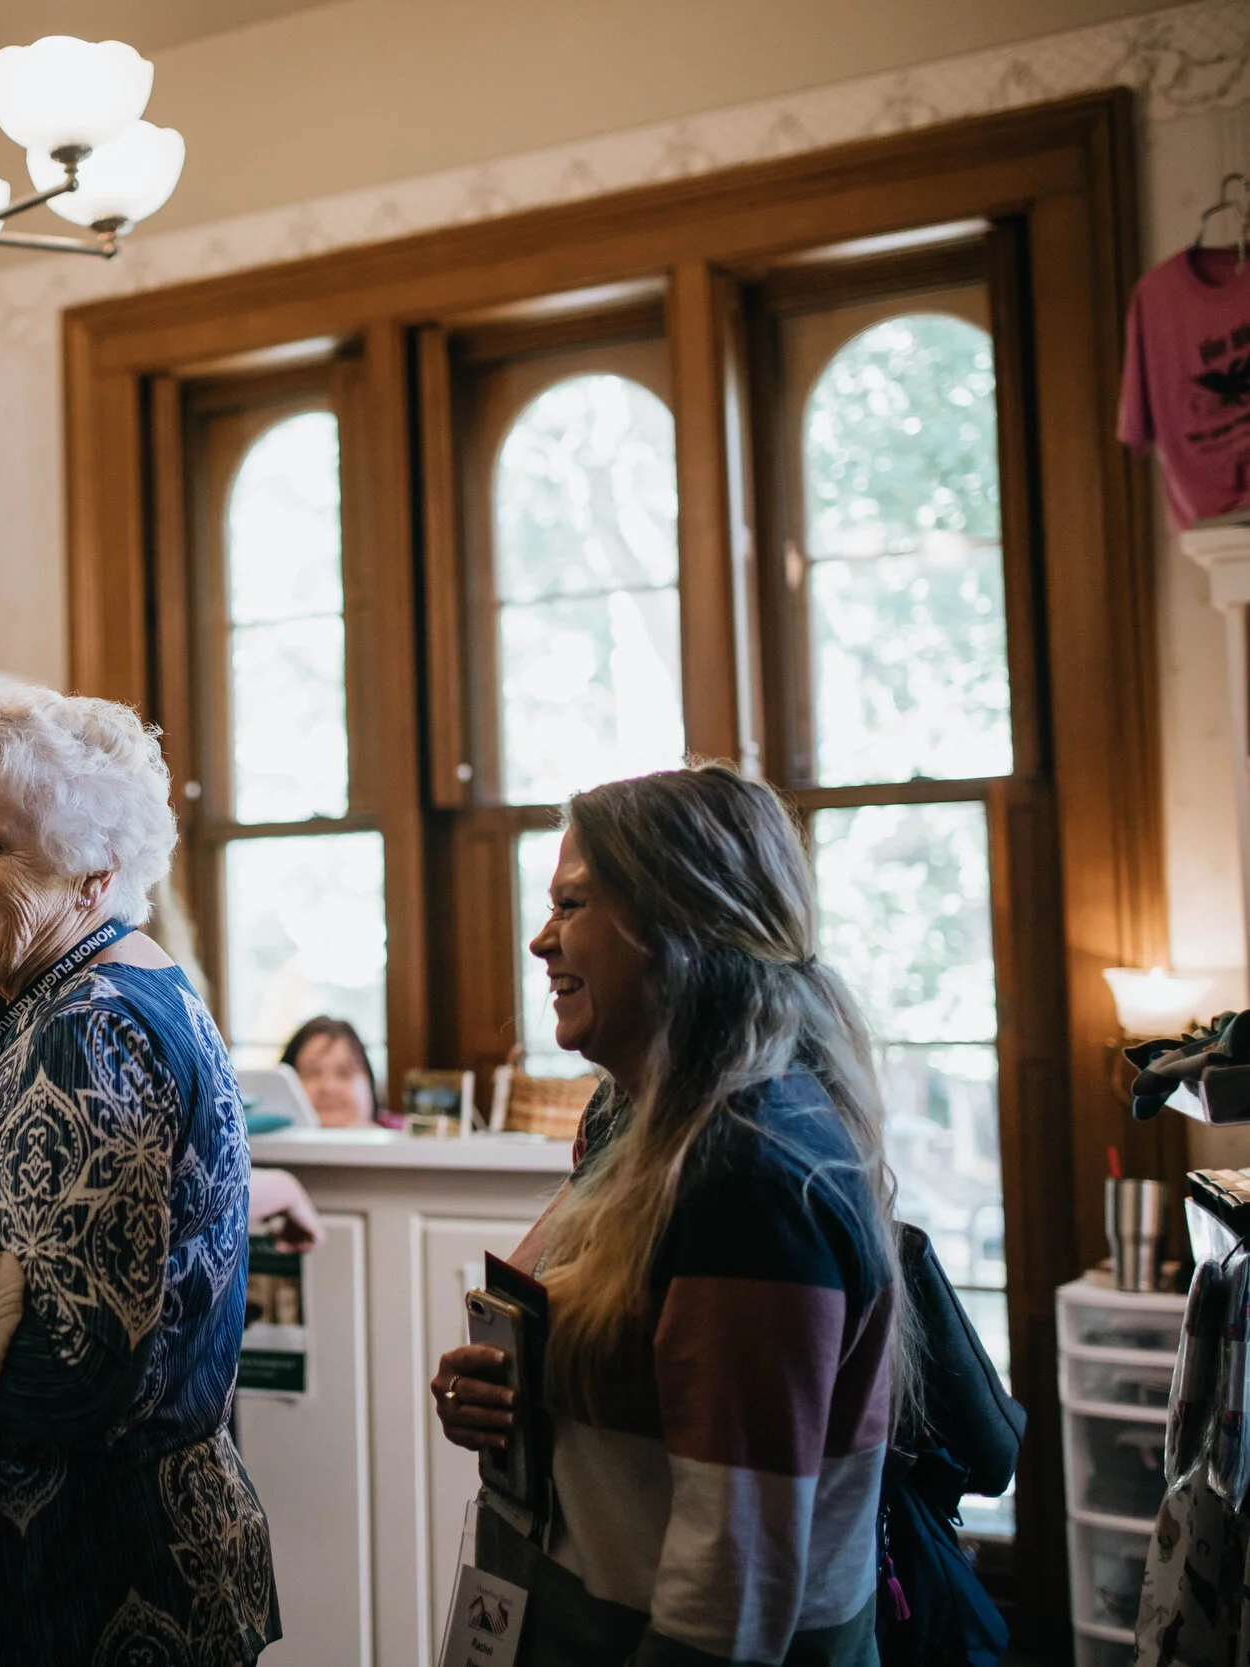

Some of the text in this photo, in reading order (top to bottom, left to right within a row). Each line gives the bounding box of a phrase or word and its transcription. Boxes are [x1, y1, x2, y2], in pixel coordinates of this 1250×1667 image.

[71, 925, 117, 963] HONOR
[33, 958, 75, 998] FLIGHT
[471, 1637, 494, 1656] Rachel
